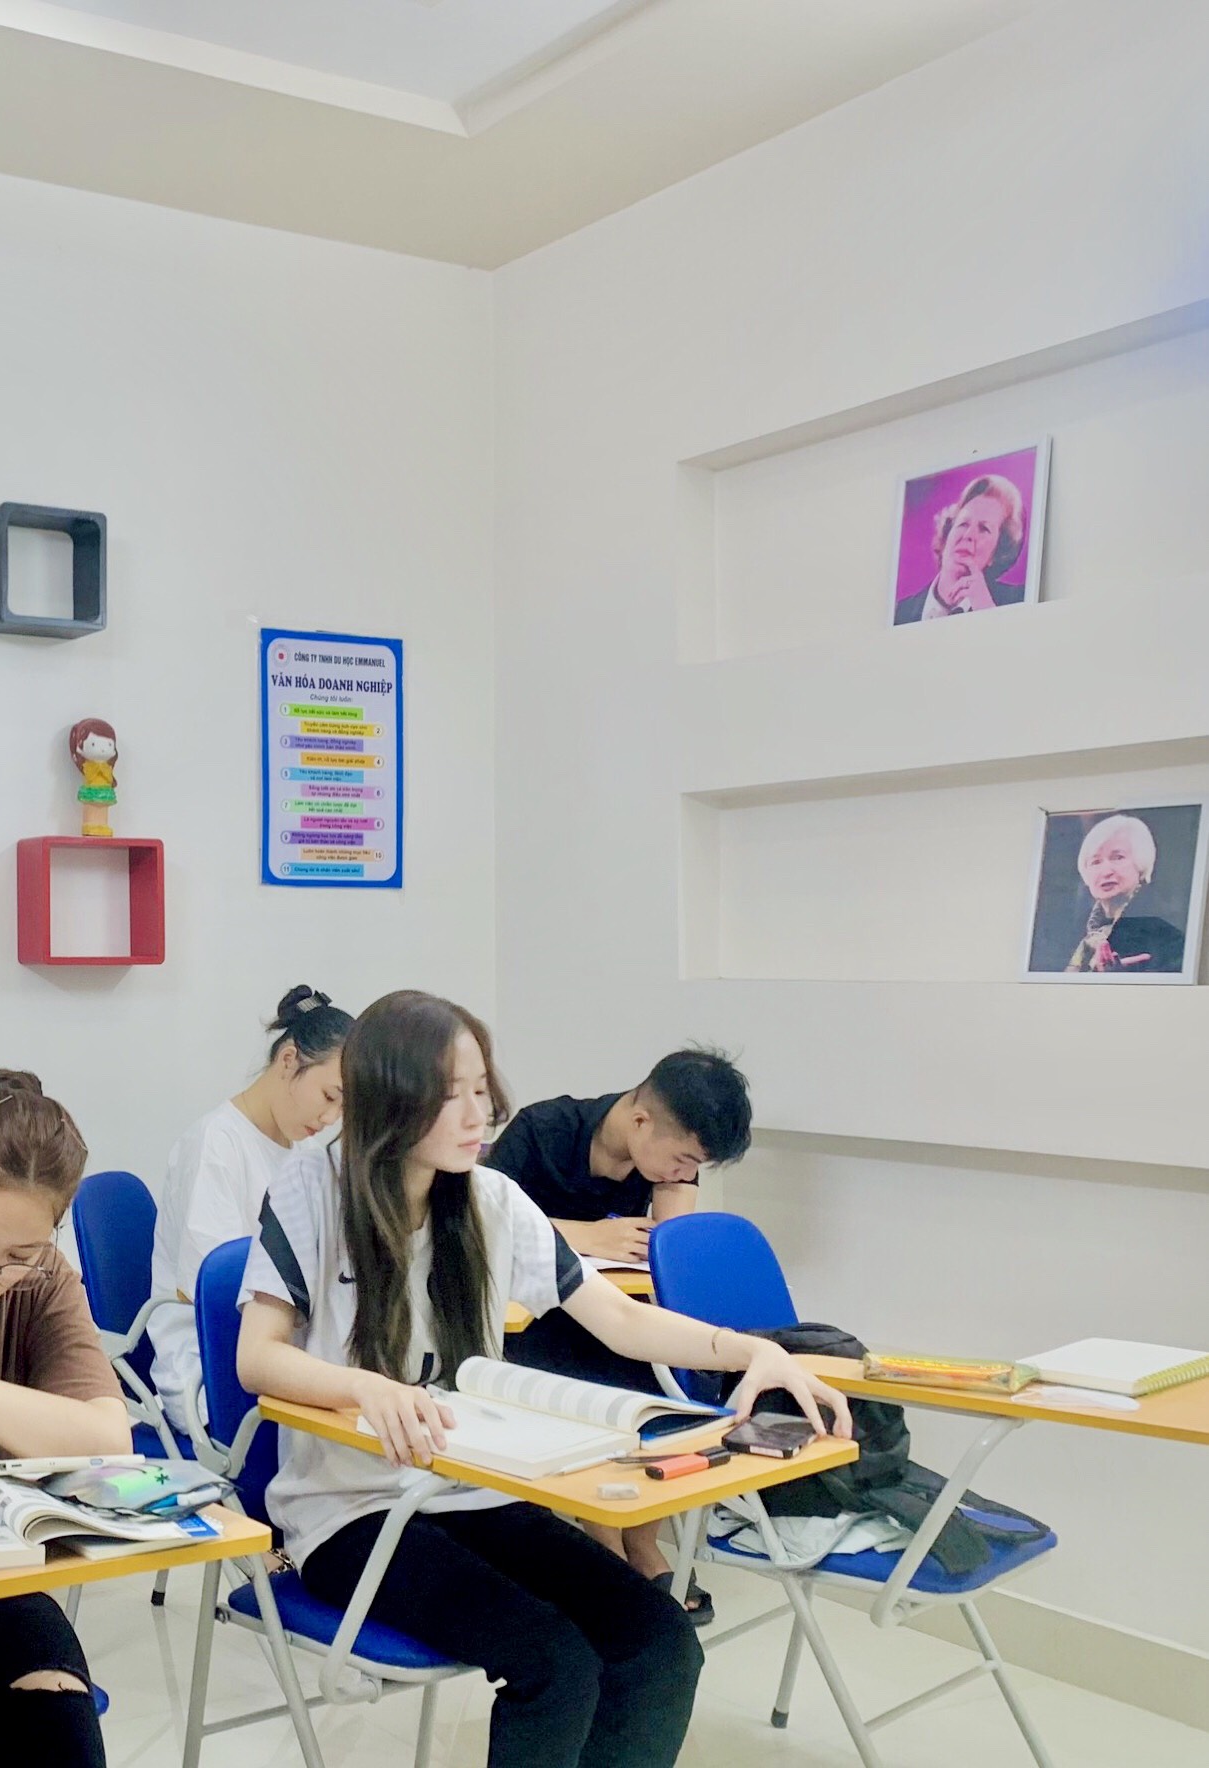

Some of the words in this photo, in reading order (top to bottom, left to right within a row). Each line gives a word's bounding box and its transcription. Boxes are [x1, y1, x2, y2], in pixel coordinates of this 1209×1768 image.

[294, 651, 310, 663] CÔNG
[311, 654, 317, 663] TY
[318, 654, 333, 664] TNHH
[334, 656, 342, 664] DU
[342, 657, 354, 667] HỌC
[355, 658, 386, 668] EMMANUEL
[271, 672, 292, 687] VĂN
[295, 674, 316, 689] HÓA
[318, 678, 353, 692] DOANH
[356, 679, 393, 696] NGHIỆP
[310, 693, 329, 703] Chúng
